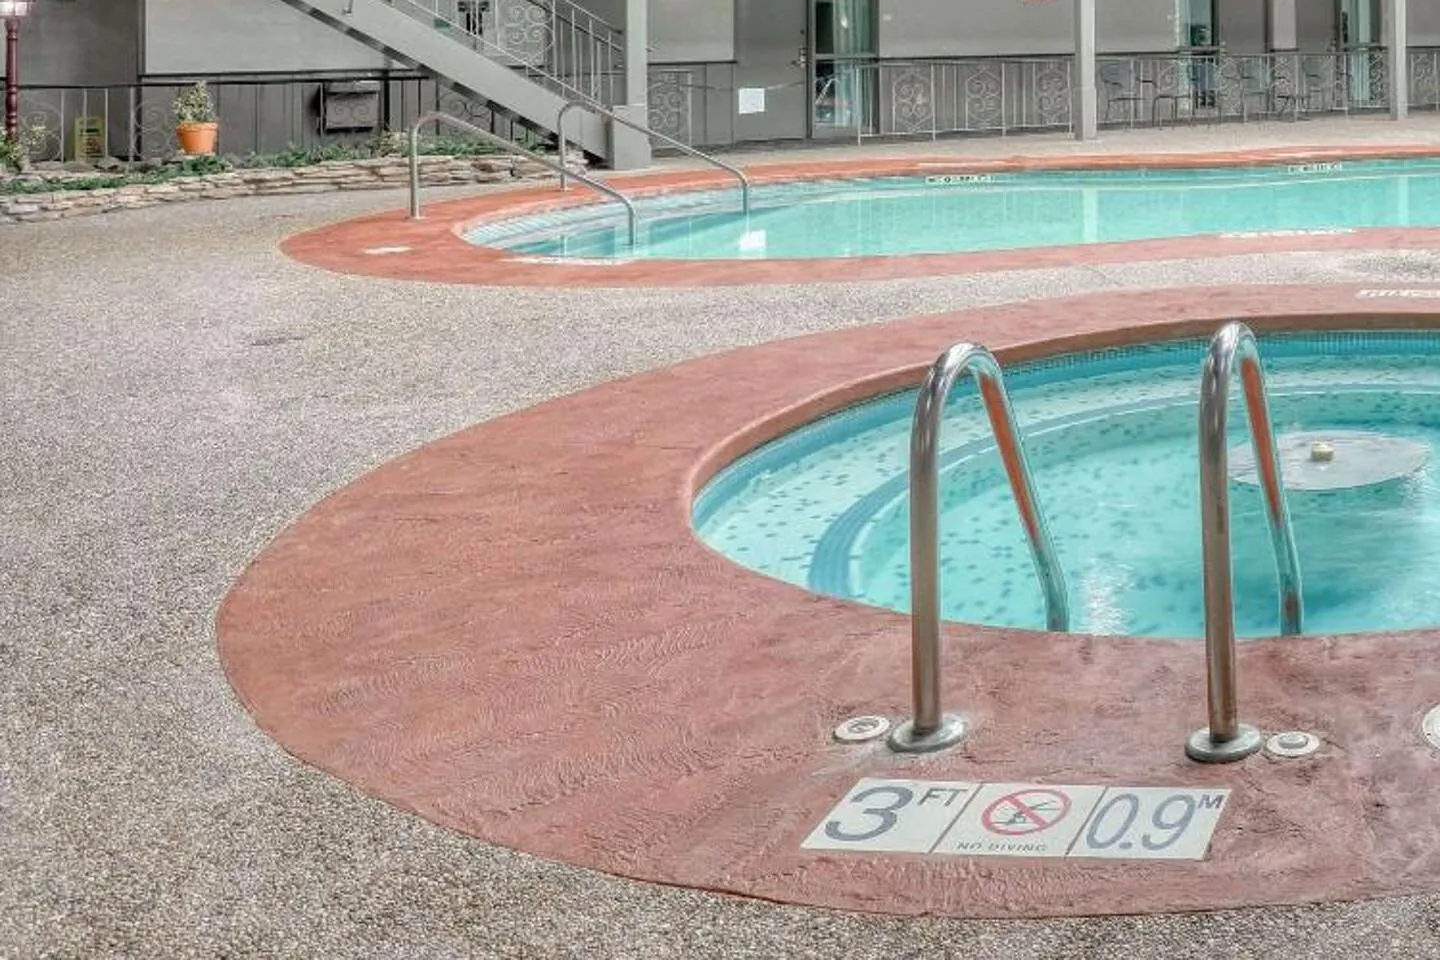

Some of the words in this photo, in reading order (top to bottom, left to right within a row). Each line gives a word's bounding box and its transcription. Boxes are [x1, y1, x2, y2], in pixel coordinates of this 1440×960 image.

[825, 786, 914, 842] 3
[918, 787, 970, 808] FT
[1086, 793, 1196, 851] 0.9
[1197, 794, 1225, 809] M
[956, 841, 982, 850] NO
[987, 842, 1048, 852] DIVING
